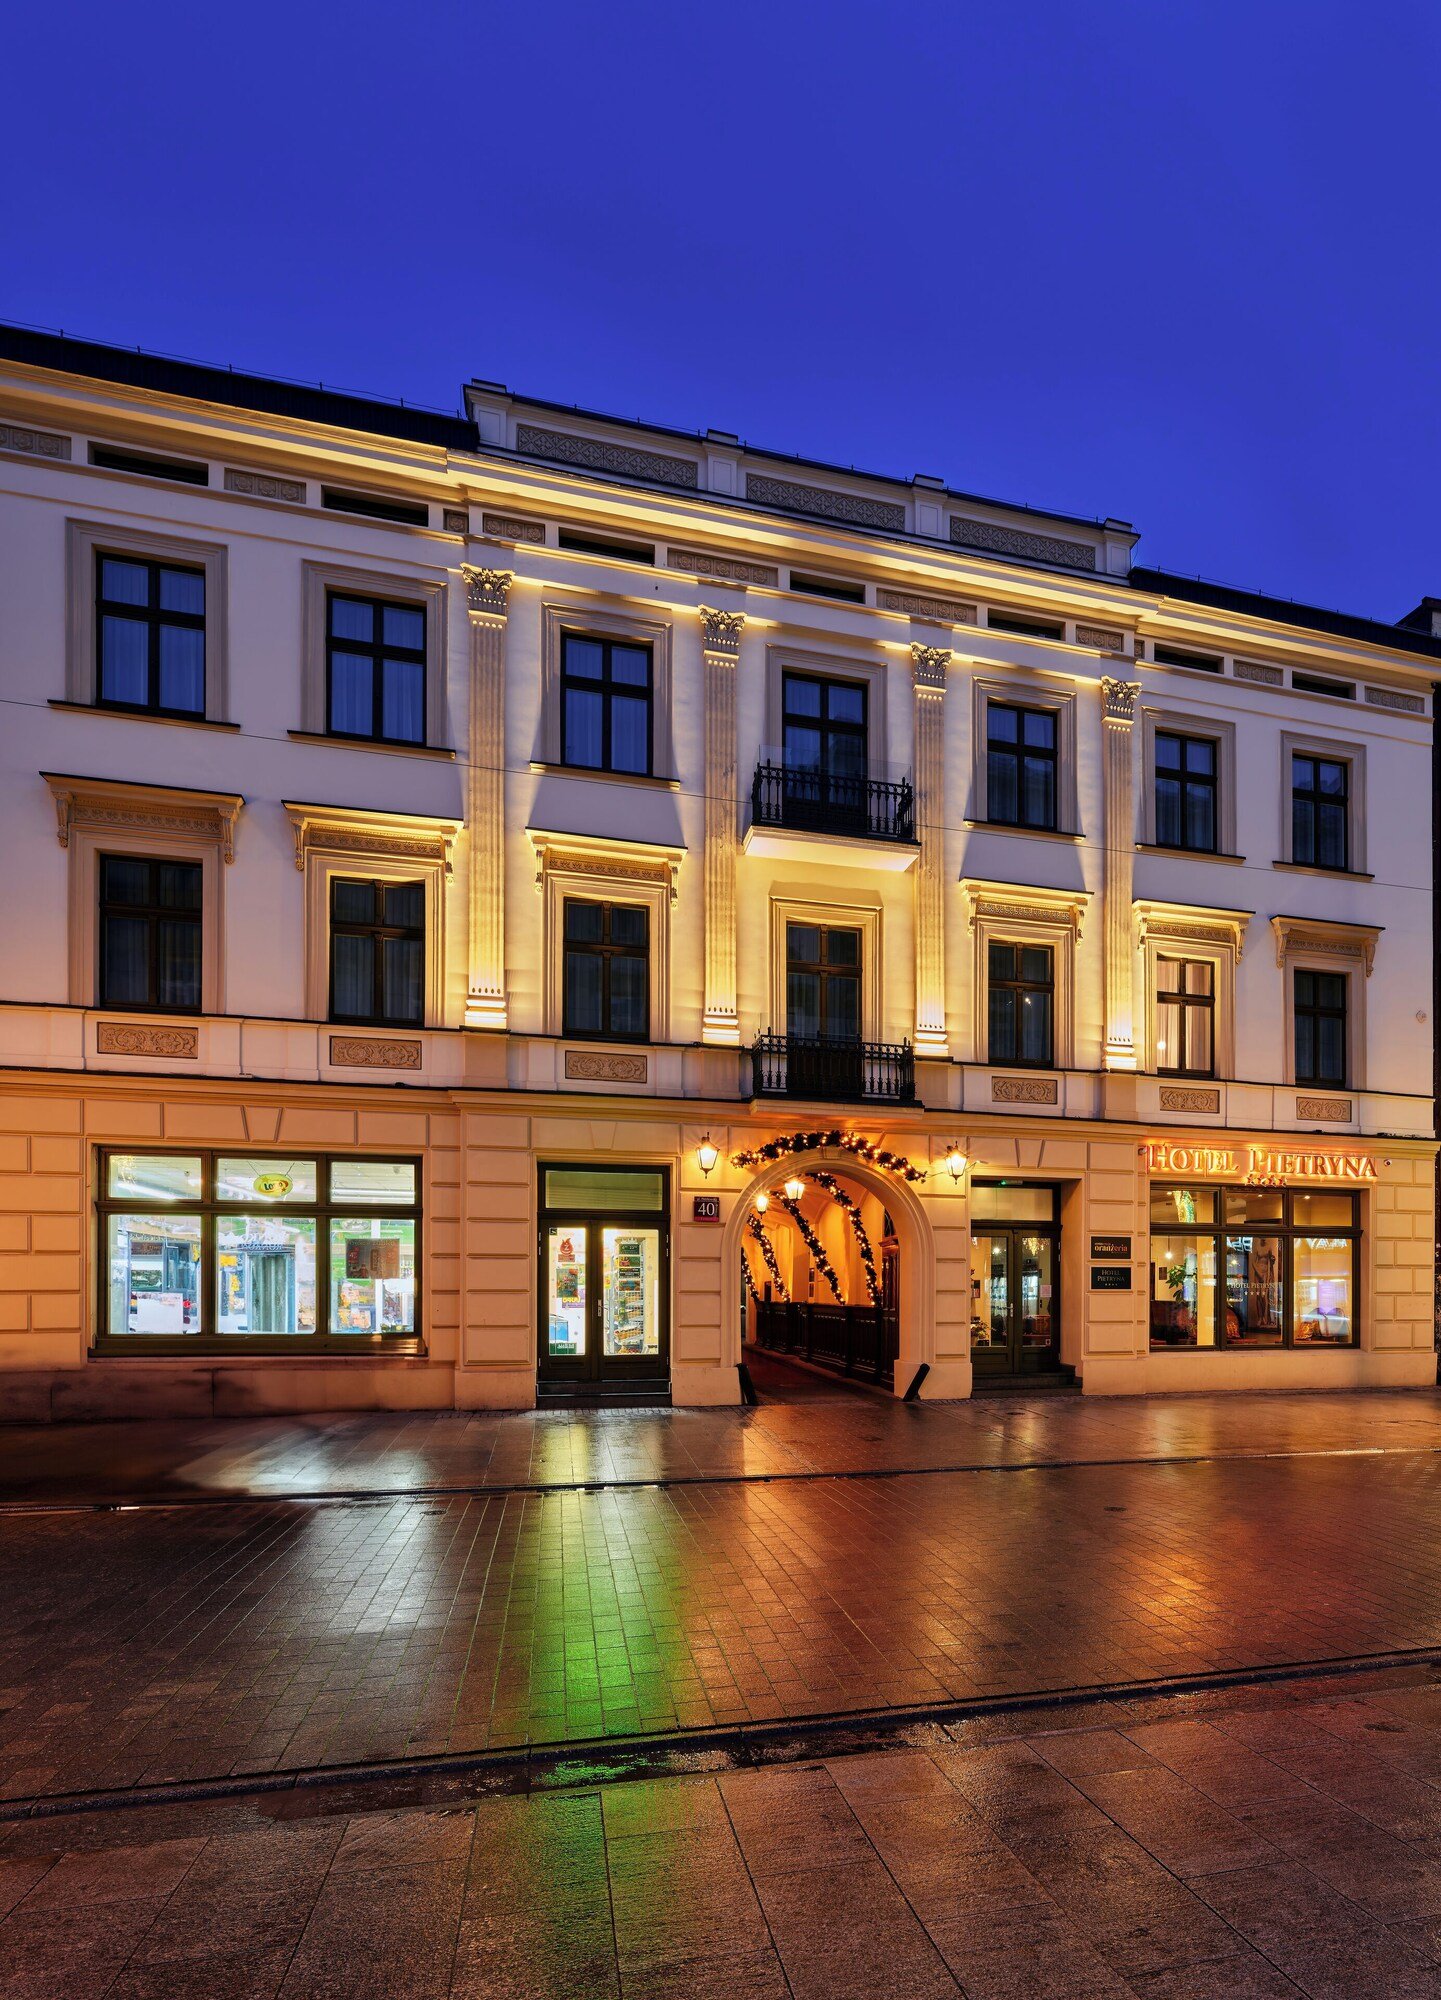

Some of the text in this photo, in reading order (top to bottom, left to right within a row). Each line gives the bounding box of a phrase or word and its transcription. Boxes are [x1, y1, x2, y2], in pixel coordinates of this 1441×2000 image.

[1149, 1144, 1379, 1178] HOTEL PIETRYNA
[698, 1202, 715, 1216] 40
[1094, 1244, 1128, 1253] oranżeria
